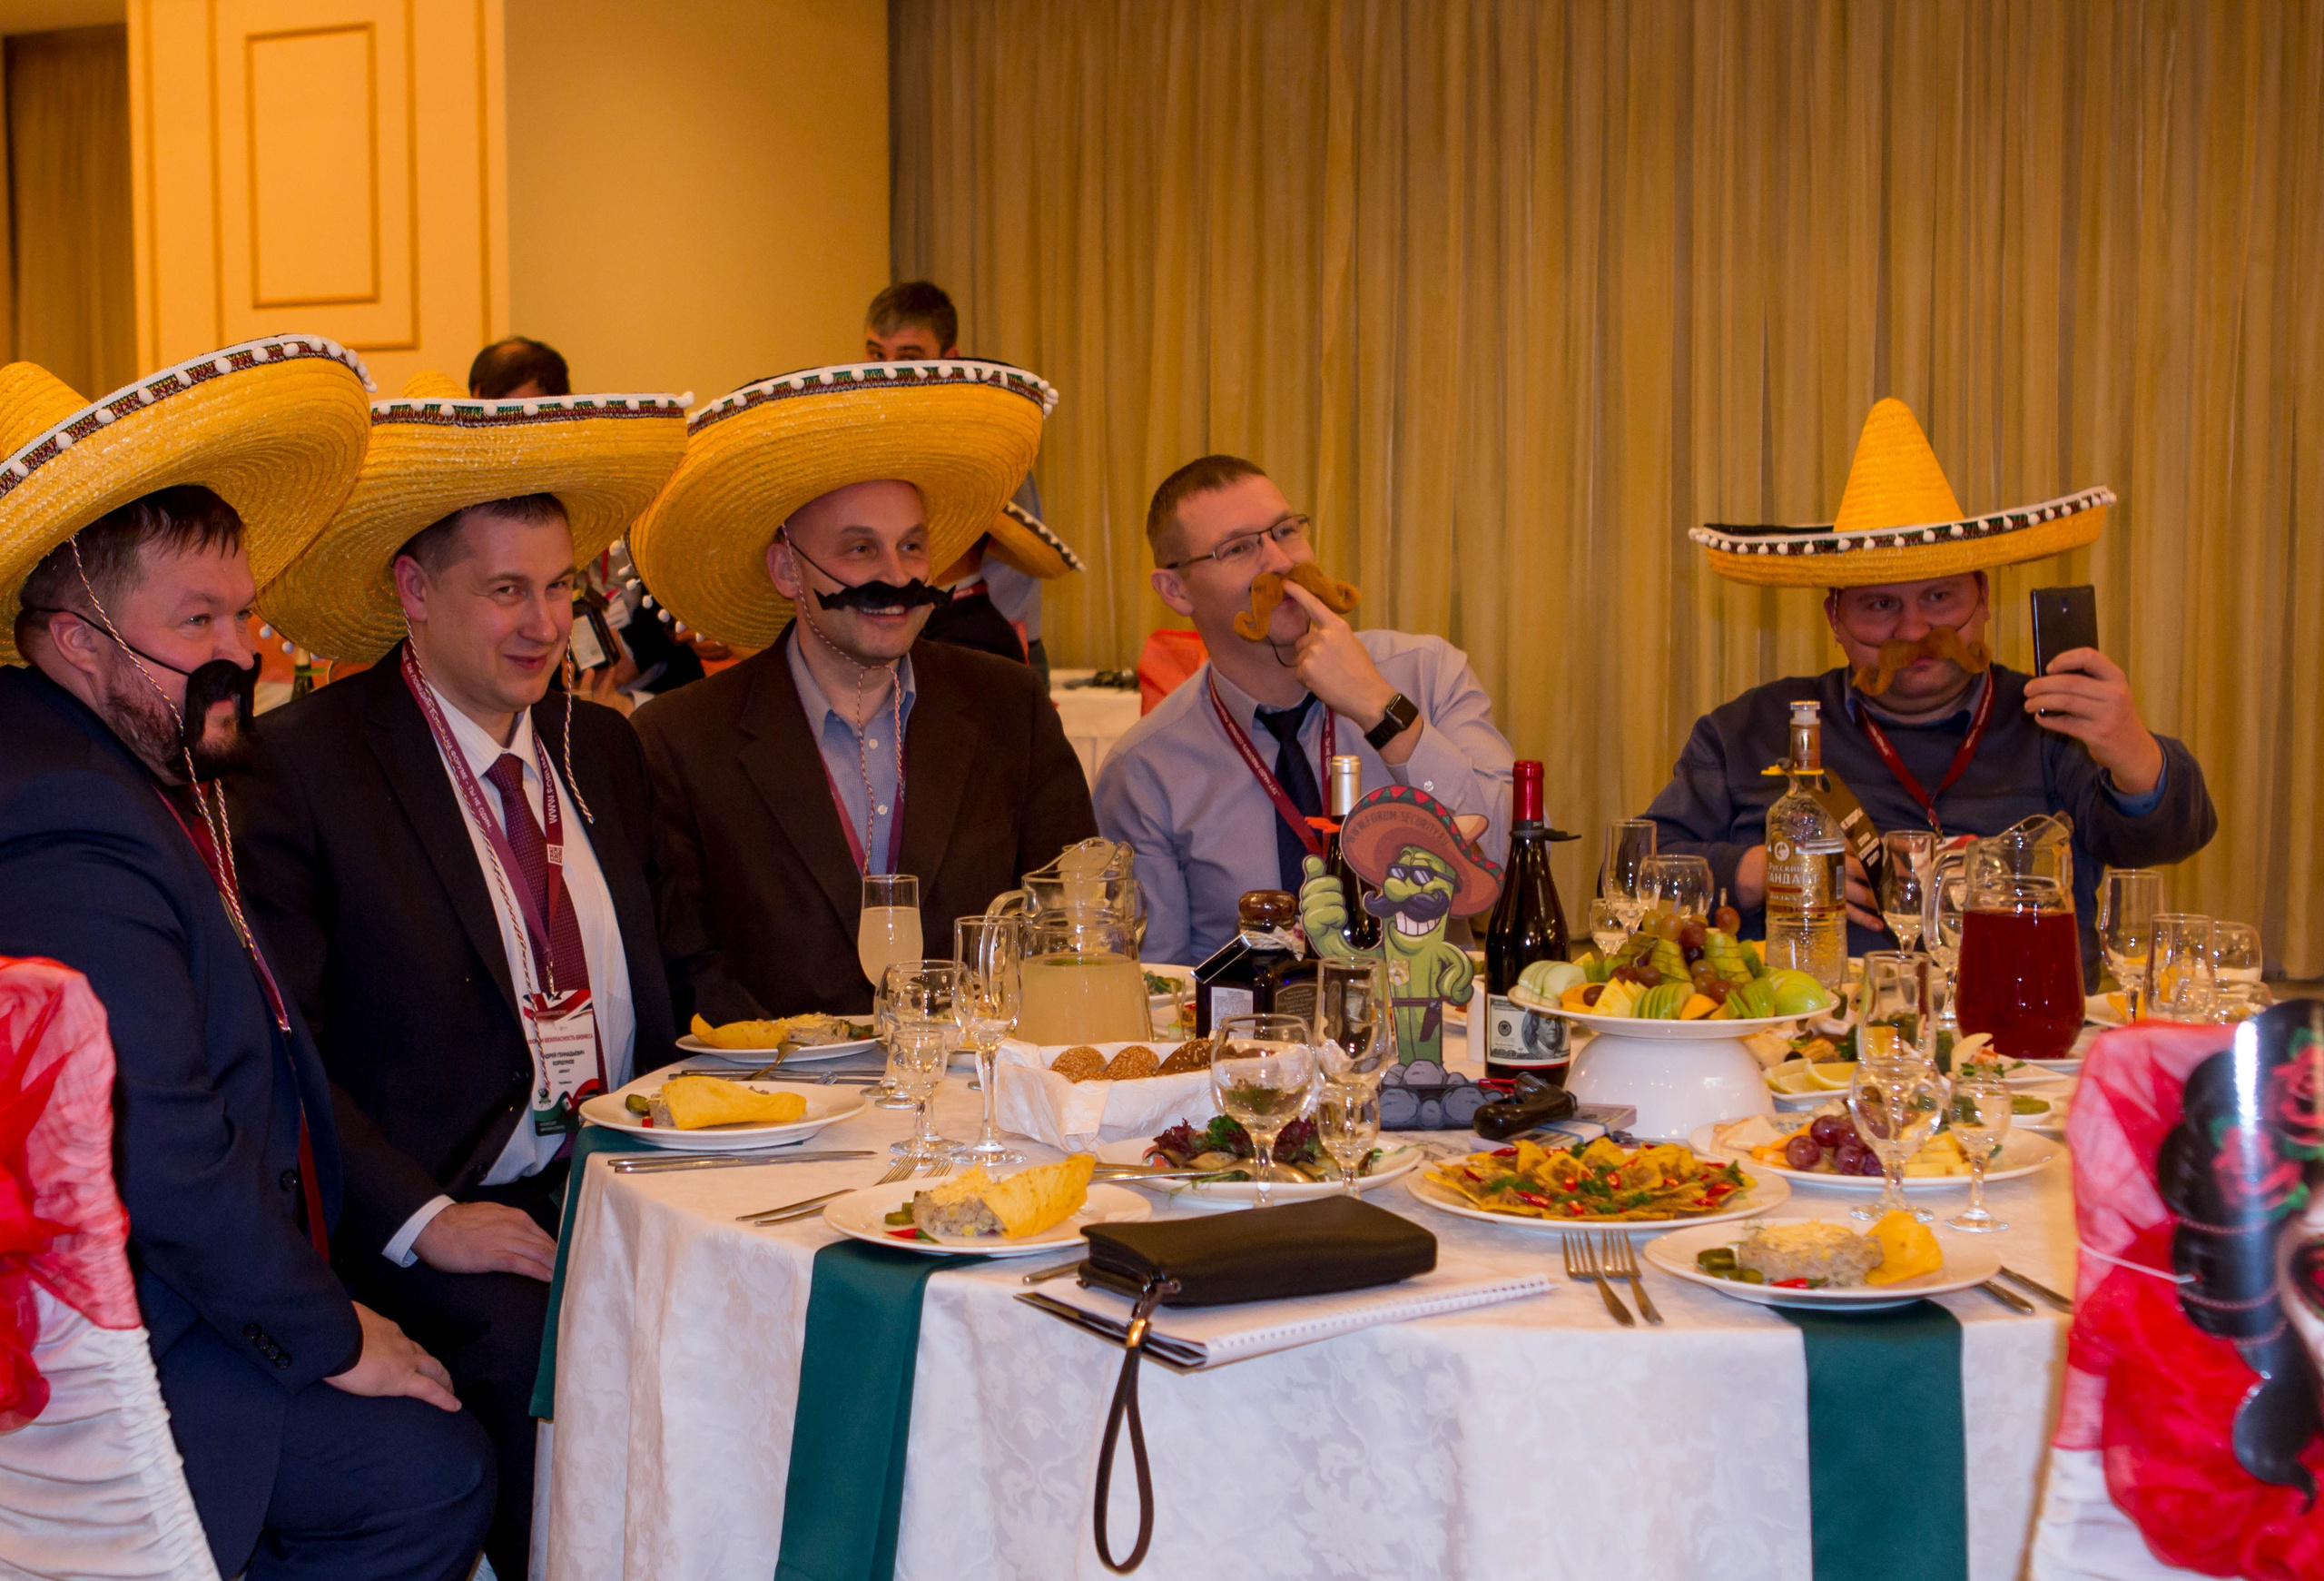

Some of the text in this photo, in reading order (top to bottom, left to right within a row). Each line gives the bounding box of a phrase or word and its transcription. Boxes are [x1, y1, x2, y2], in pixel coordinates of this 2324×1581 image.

[450, 750, 468, 780] ФОРУМЕ
[468, 785, 477, 796] ТЫ
[473, 795, 482, 807] НЕ
